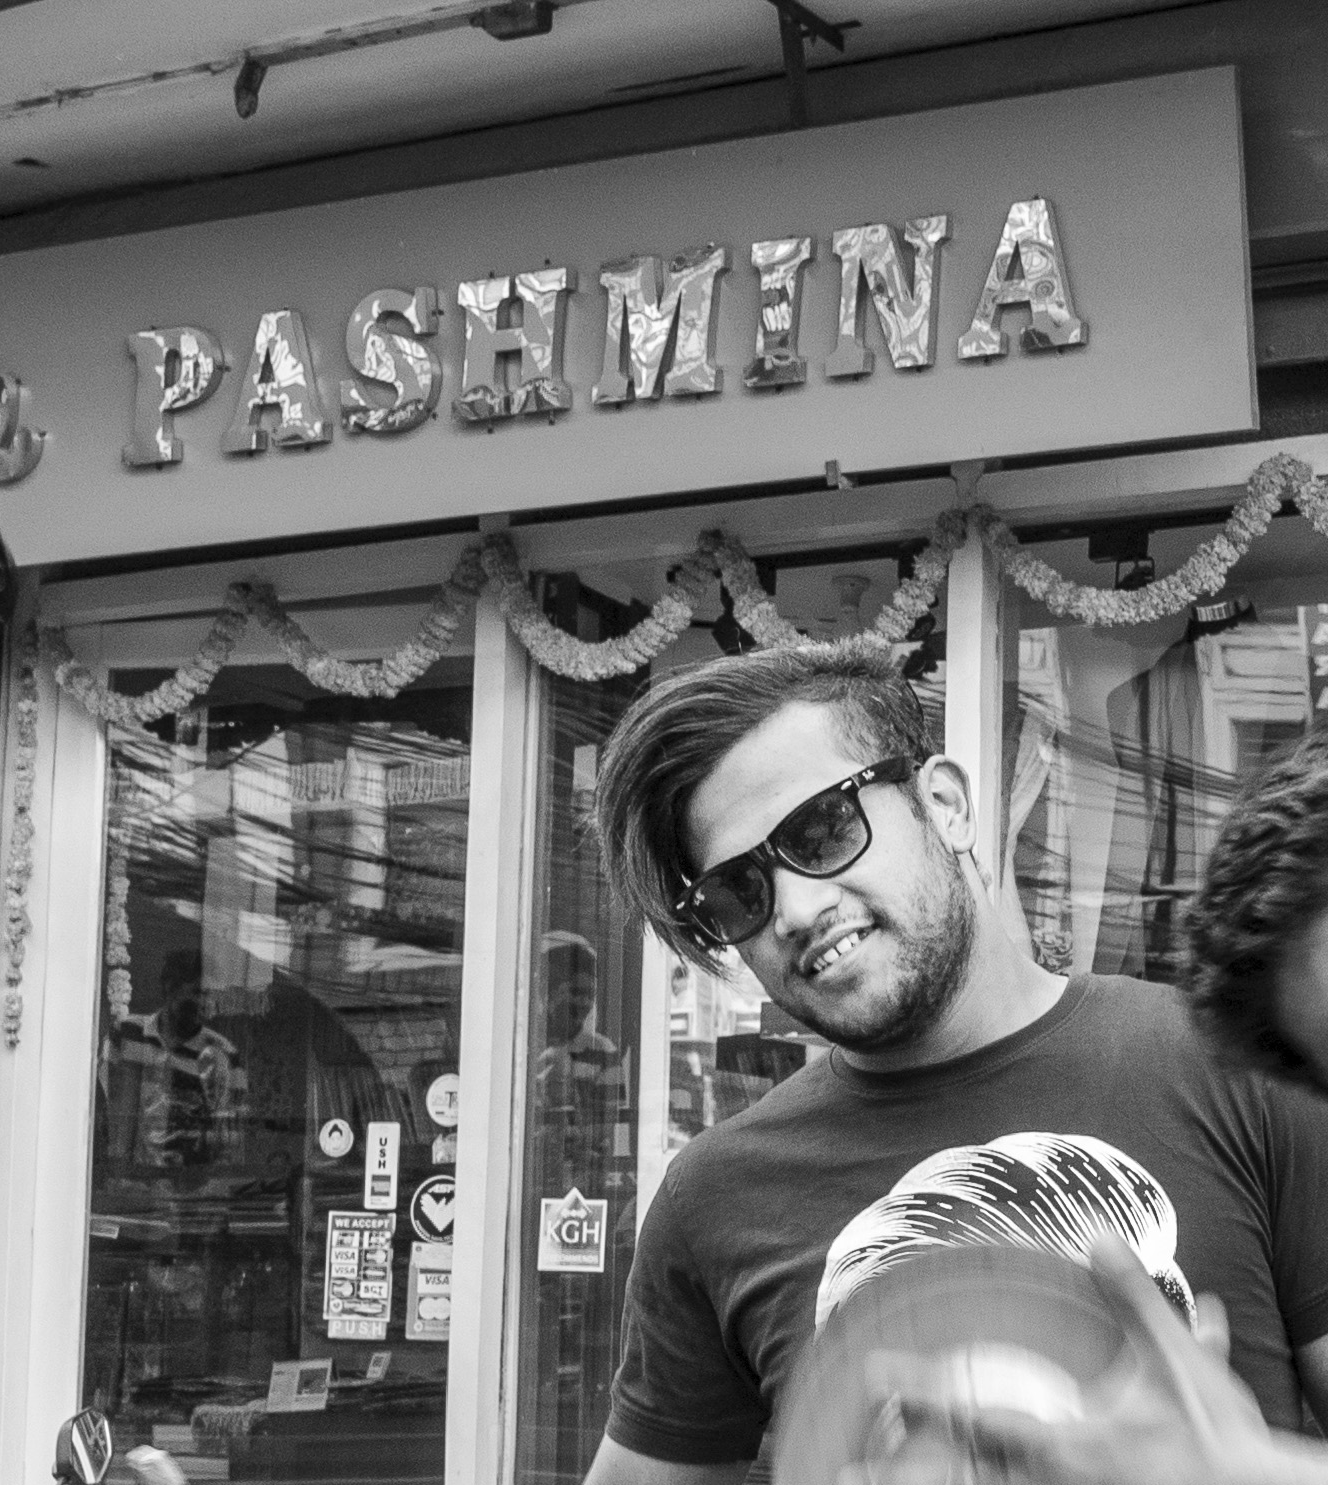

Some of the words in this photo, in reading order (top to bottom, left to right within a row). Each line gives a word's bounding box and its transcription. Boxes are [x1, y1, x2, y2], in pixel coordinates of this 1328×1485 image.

[122, 196, 1089, 466] PASHMINA
[334, 1218, 350, 1228] WE
[352, 1218, 390, 1229] ACCEPT
[546, 1219, 601, 1245] KGH
[334, 1250, 356, 1260] VISA
[334, 1266, 356, 1275] VISA
[425, 1275, 450, 1285] VISA
[332, 1320, 383, 1335] PUSH
